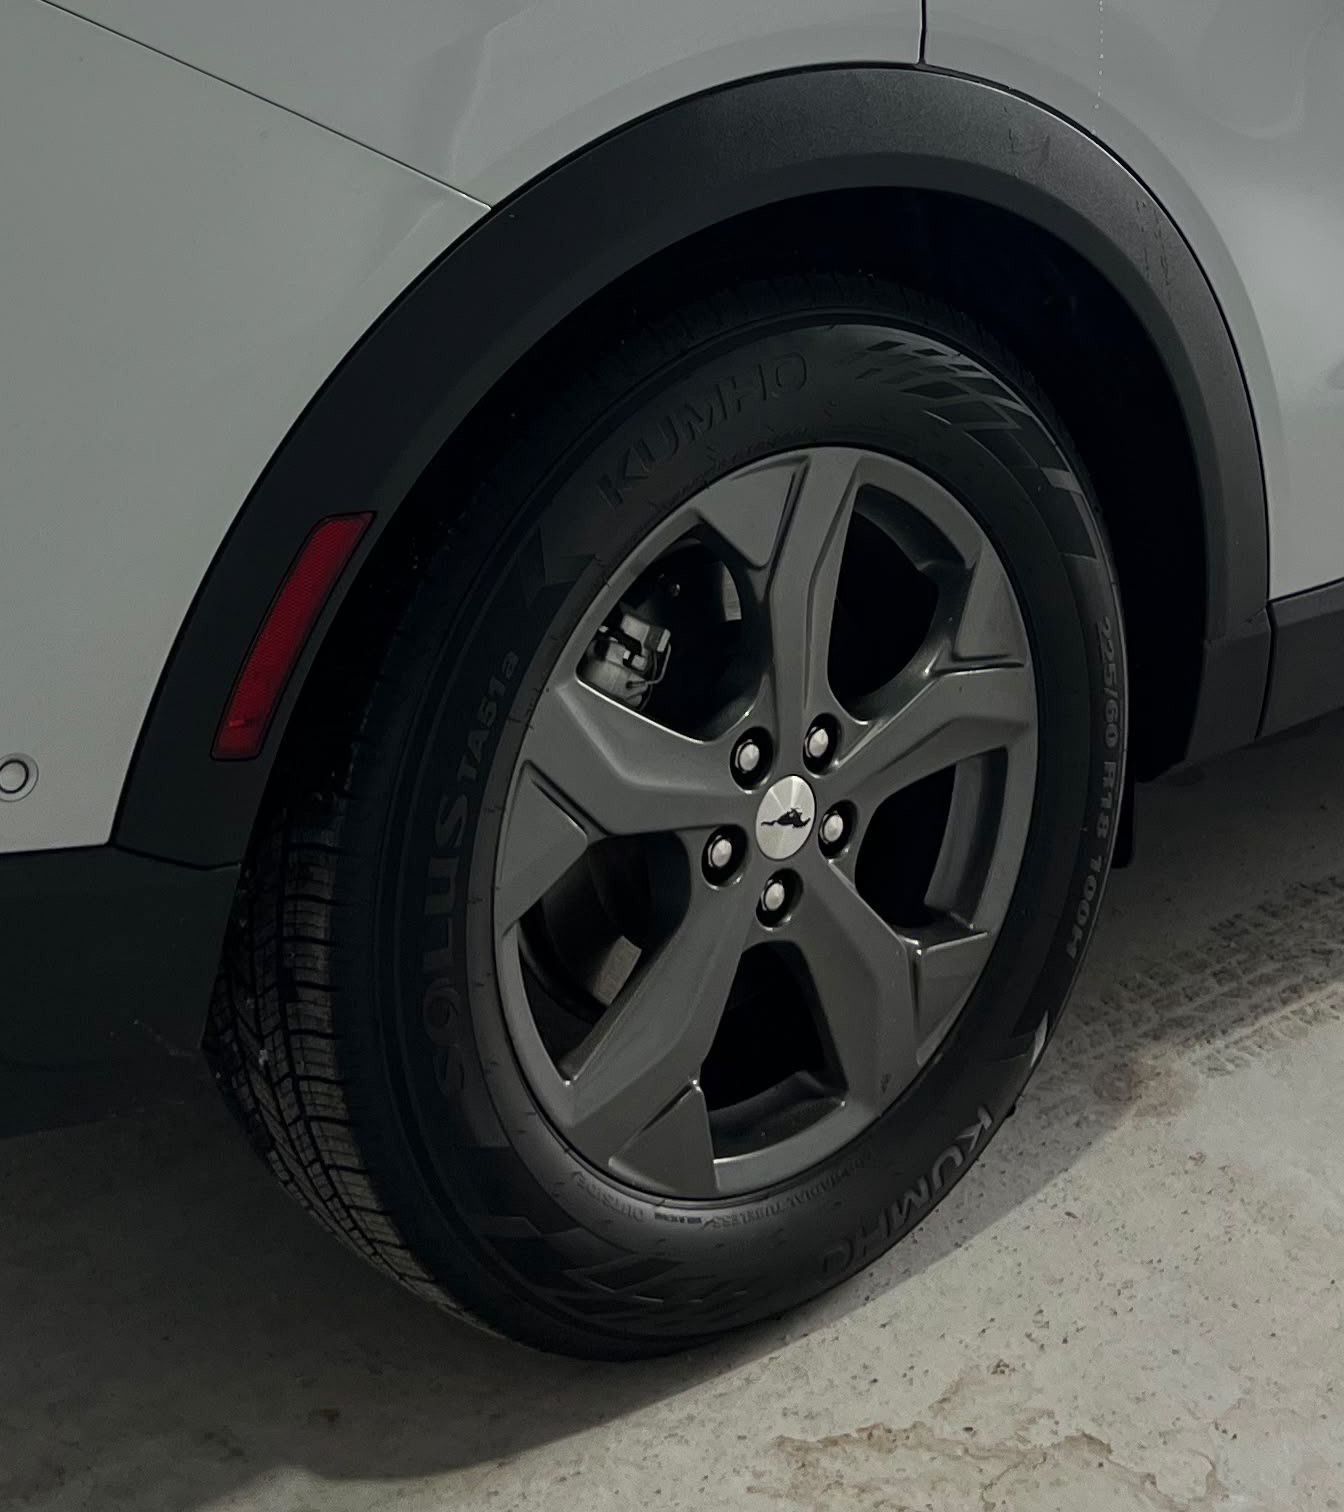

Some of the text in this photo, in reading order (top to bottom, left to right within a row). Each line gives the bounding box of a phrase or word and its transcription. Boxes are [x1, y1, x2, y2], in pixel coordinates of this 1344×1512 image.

[596, 350, 809, 511] KUMHO
[1066, 617, 1120, 960] 225/60 R18 100H
[421, 794, 469, 1096] SOLUS
[822, 1104, 993, 1273] KUMHO
